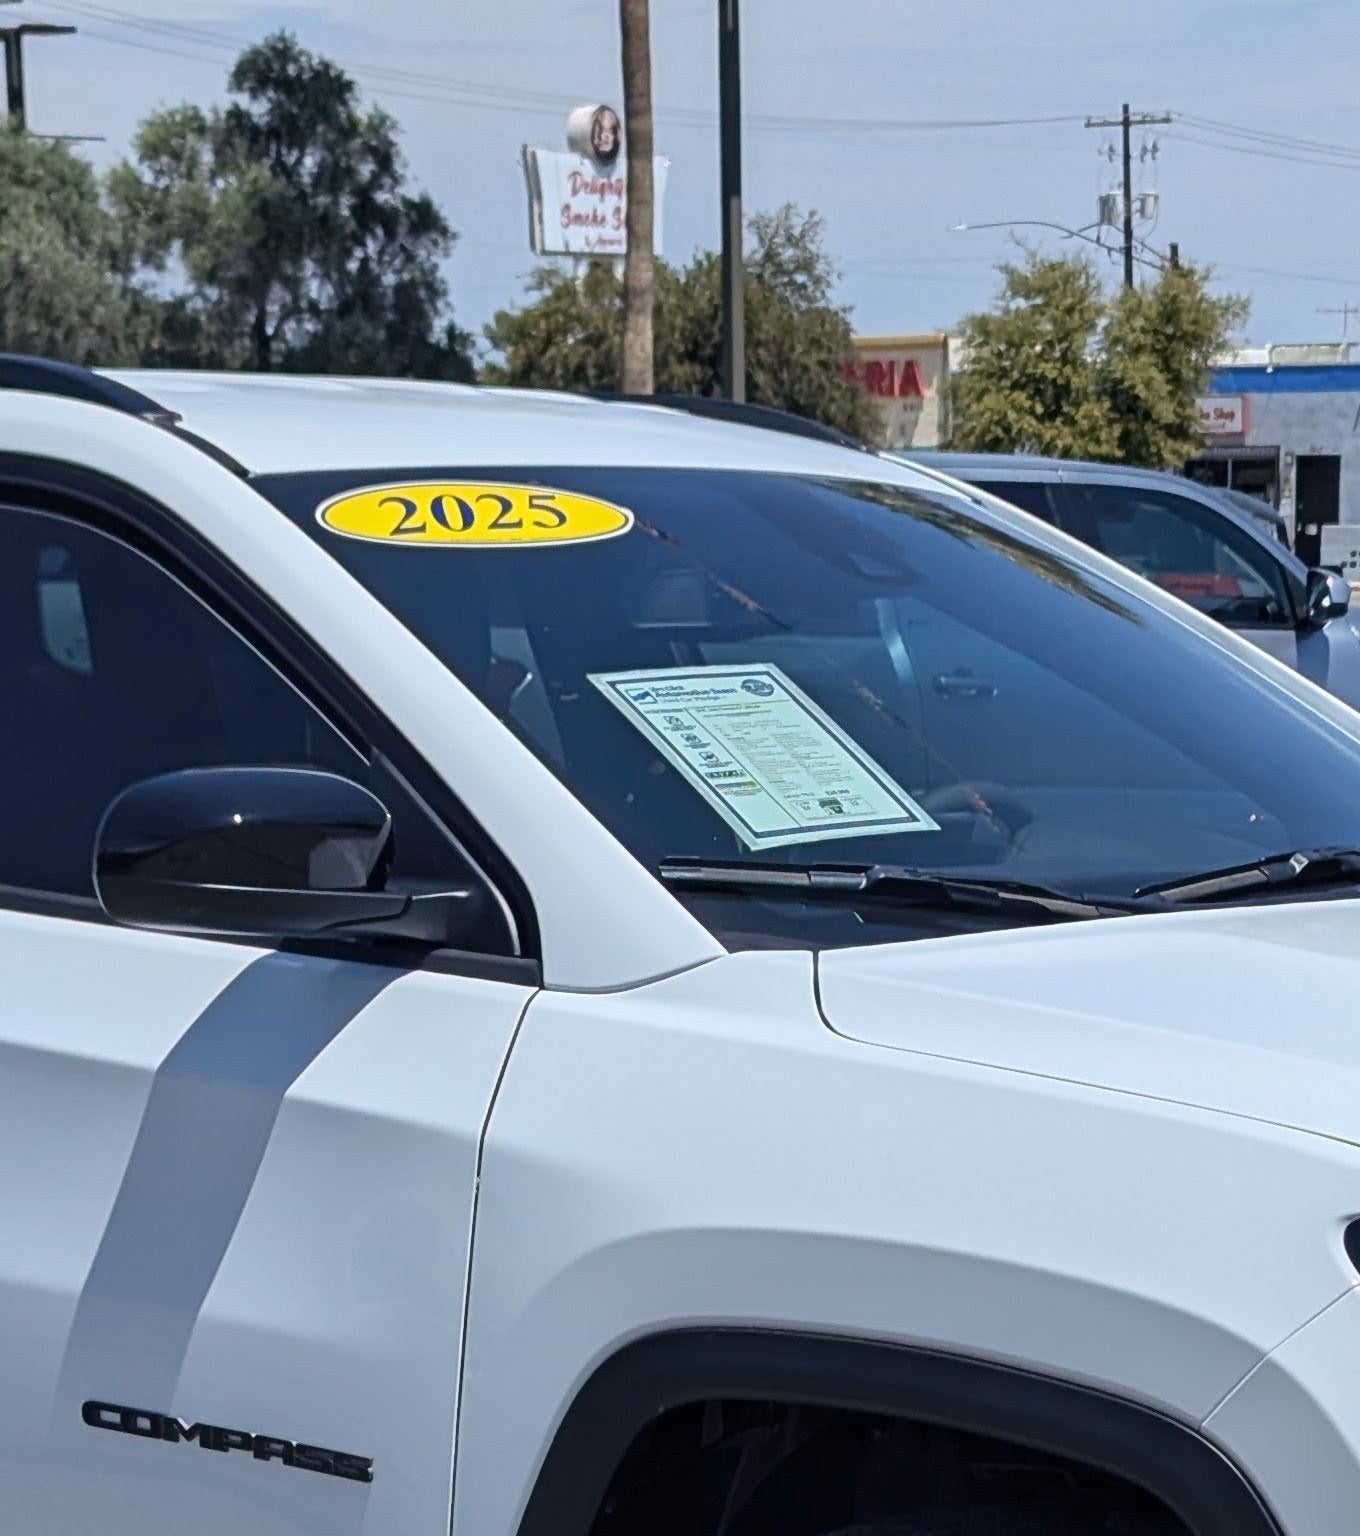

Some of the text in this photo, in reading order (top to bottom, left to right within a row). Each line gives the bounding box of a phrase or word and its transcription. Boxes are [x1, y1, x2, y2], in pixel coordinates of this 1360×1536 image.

[561, 203, 607, 229] Smoke
[378, 494, 567, 536] 2025
[81, 1399, 374, 1483] COMPASS
